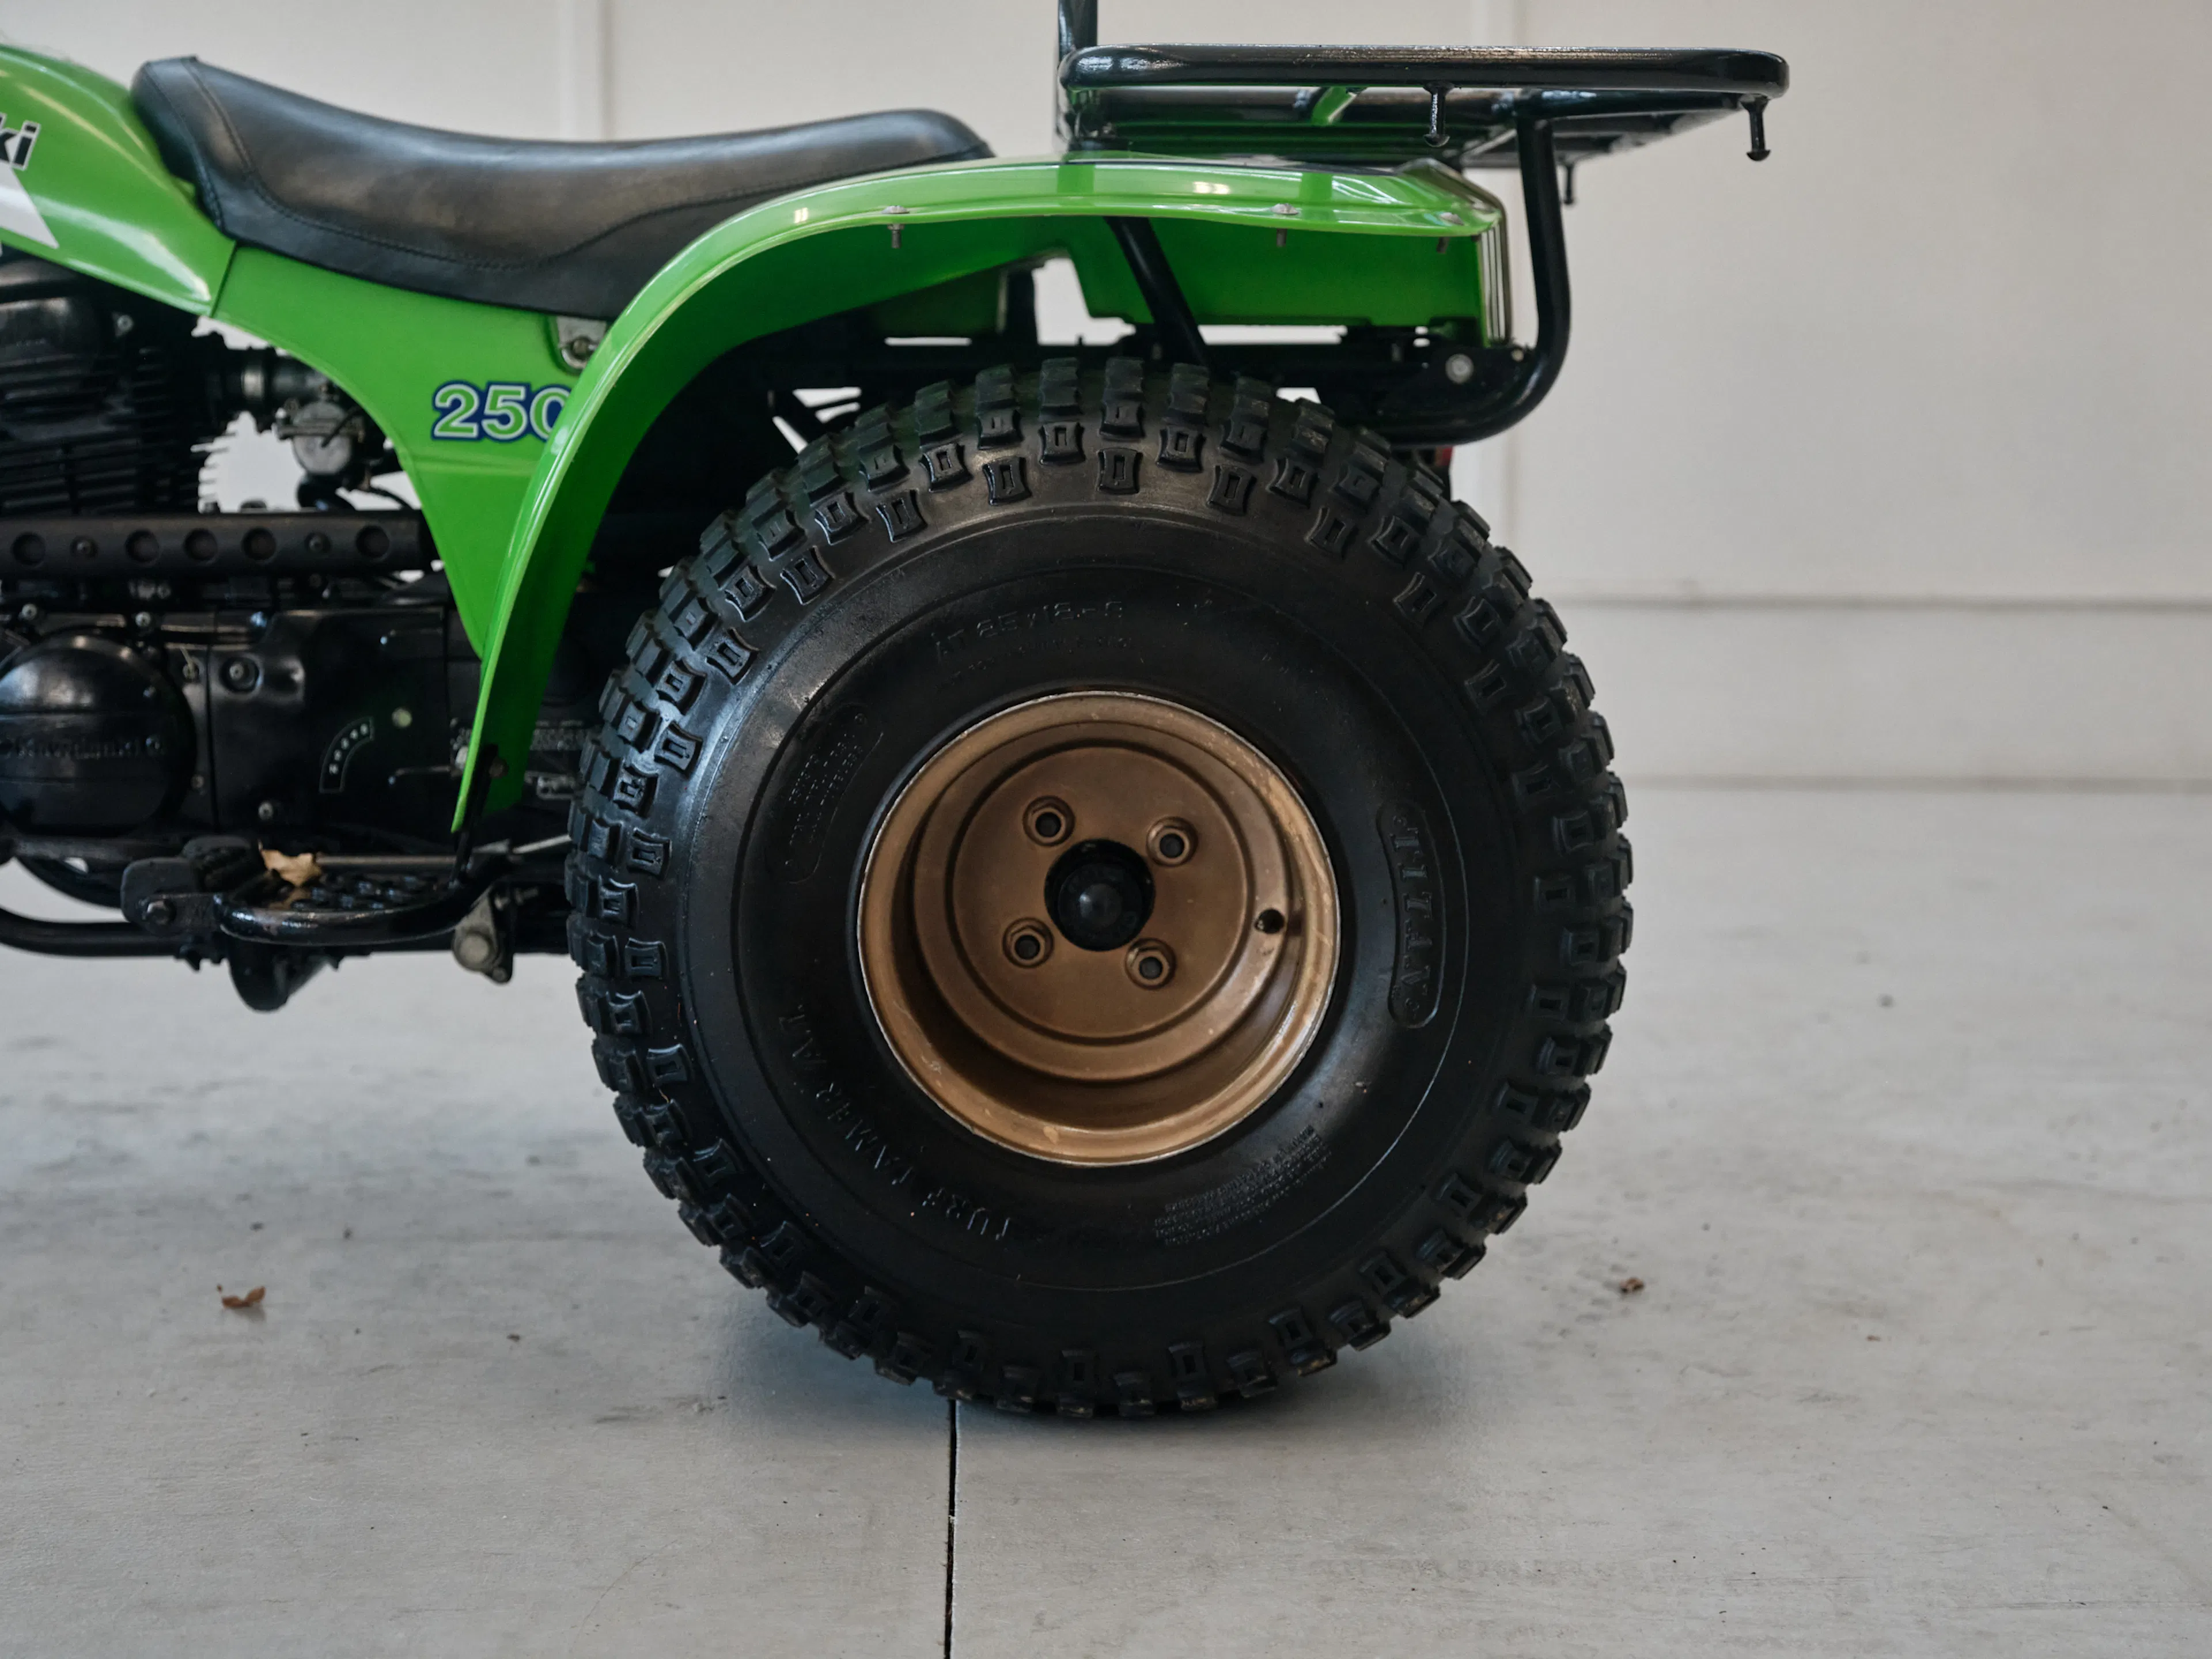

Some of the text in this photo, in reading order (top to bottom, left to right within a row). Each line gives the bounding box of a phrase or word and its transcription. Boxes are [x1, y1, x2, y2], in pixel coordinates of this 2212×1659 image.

[431, 380, 571, 443] 250
[1389, 827, 1434, 995] TITAN
[816, 1082, 914, 1185] TAMER
[922, 1187, 1012, 1241] TURF
